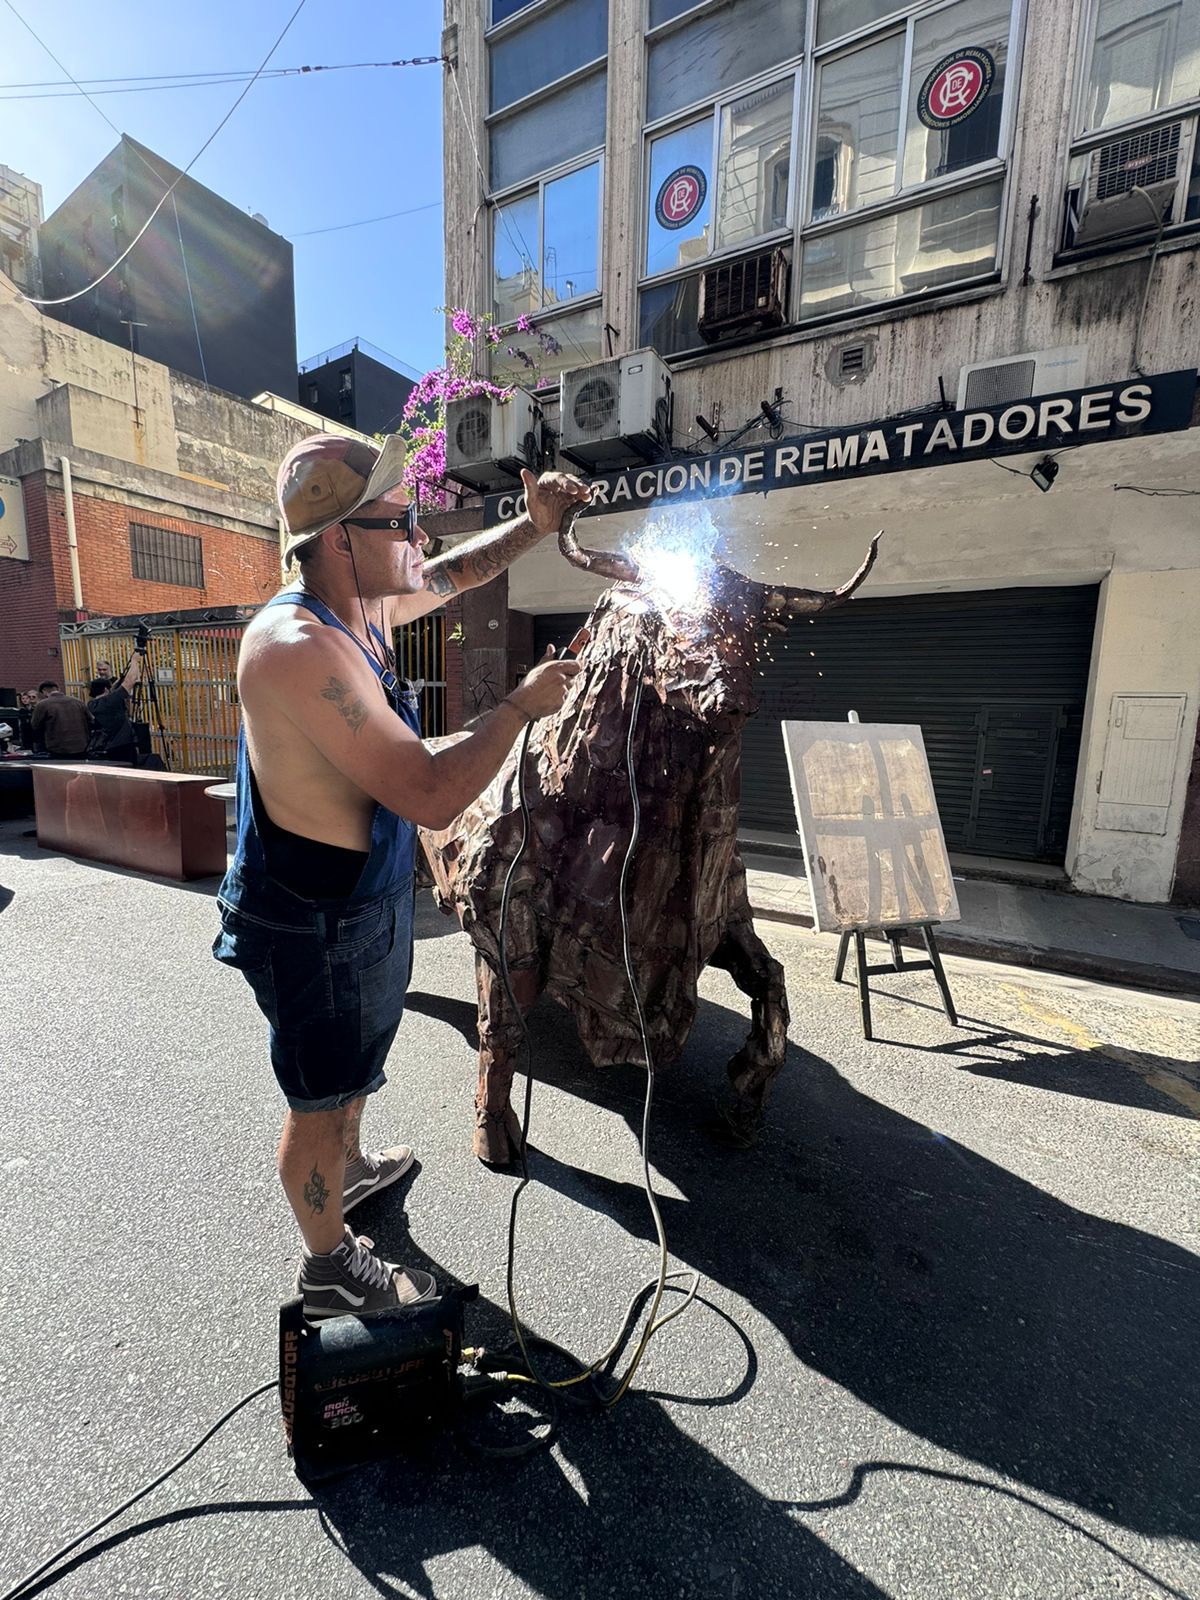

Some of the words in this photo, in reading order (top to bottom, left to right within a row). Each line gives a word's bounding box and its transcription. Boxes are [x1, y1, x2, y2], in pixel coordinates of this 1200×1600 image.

[951, 79, 963, 91] DE
[497, 460, 711, 520] CORACION
[719, 451, 765, 486] DE
[774, 384, 1152, 478] REMATADORES
[323, 1404, 358, 1419] BLACK
[324, 1400, 350, 1412] IRON
